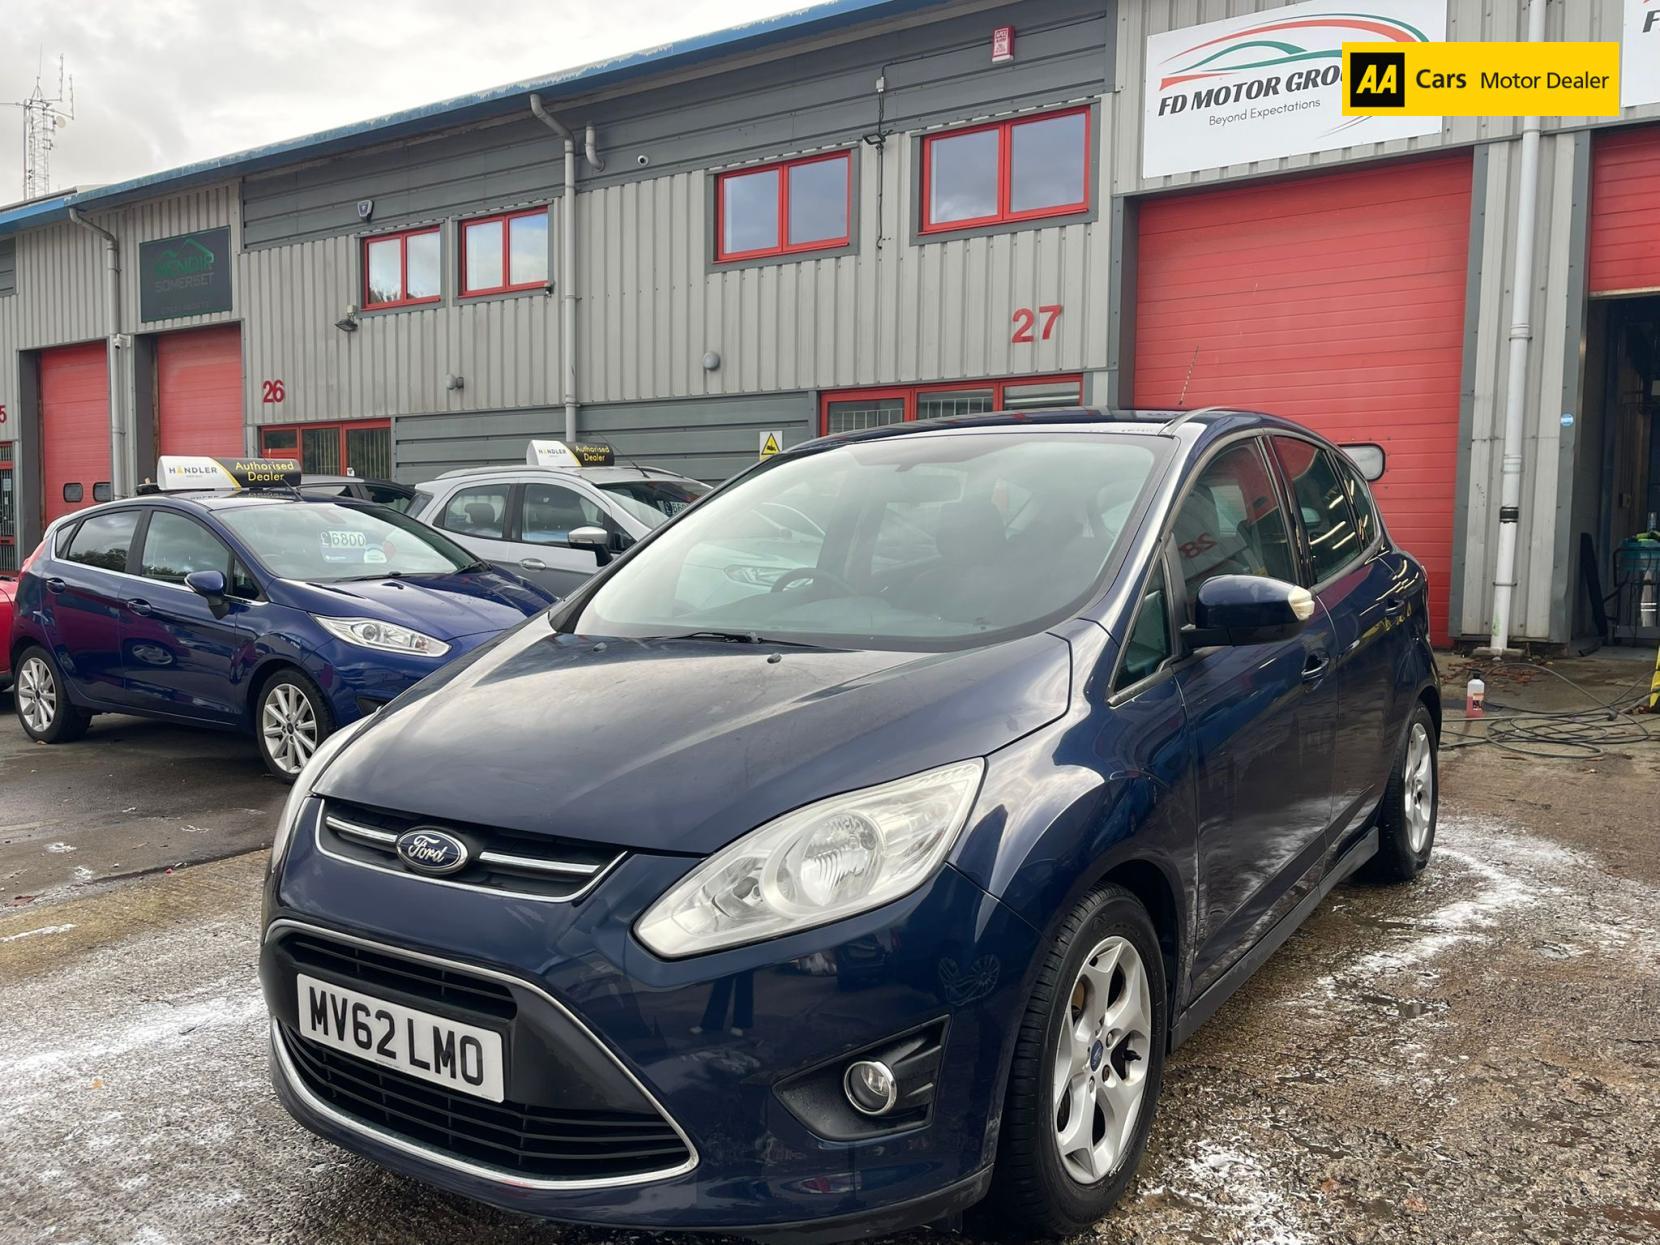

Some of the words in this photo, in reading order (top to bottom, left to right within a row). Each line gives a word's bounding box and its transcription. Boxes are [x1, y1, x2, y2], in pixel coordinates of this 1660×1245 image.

[1158, 94, 1188, 116] FD
[1191, 76, 1281, 111] MOTOR
[1285, 65, 1342, 93] GRO
[1209, 109, 1248, 127] Beyond
[1250, 99, 1321, 120] Expectations
[1011, 304, 1063, 344] 27
[262, 379, 285, 403] 26
[235, 461, 295, 471] Authorised
[583, 453, 606, 462] Dealer
[247, 471, 285, 481] Dealer
[407, 835, 449, 863] Ford
[309, 986, 397, 1060] MV62
[407, 1017, 484, 1087] LMO
